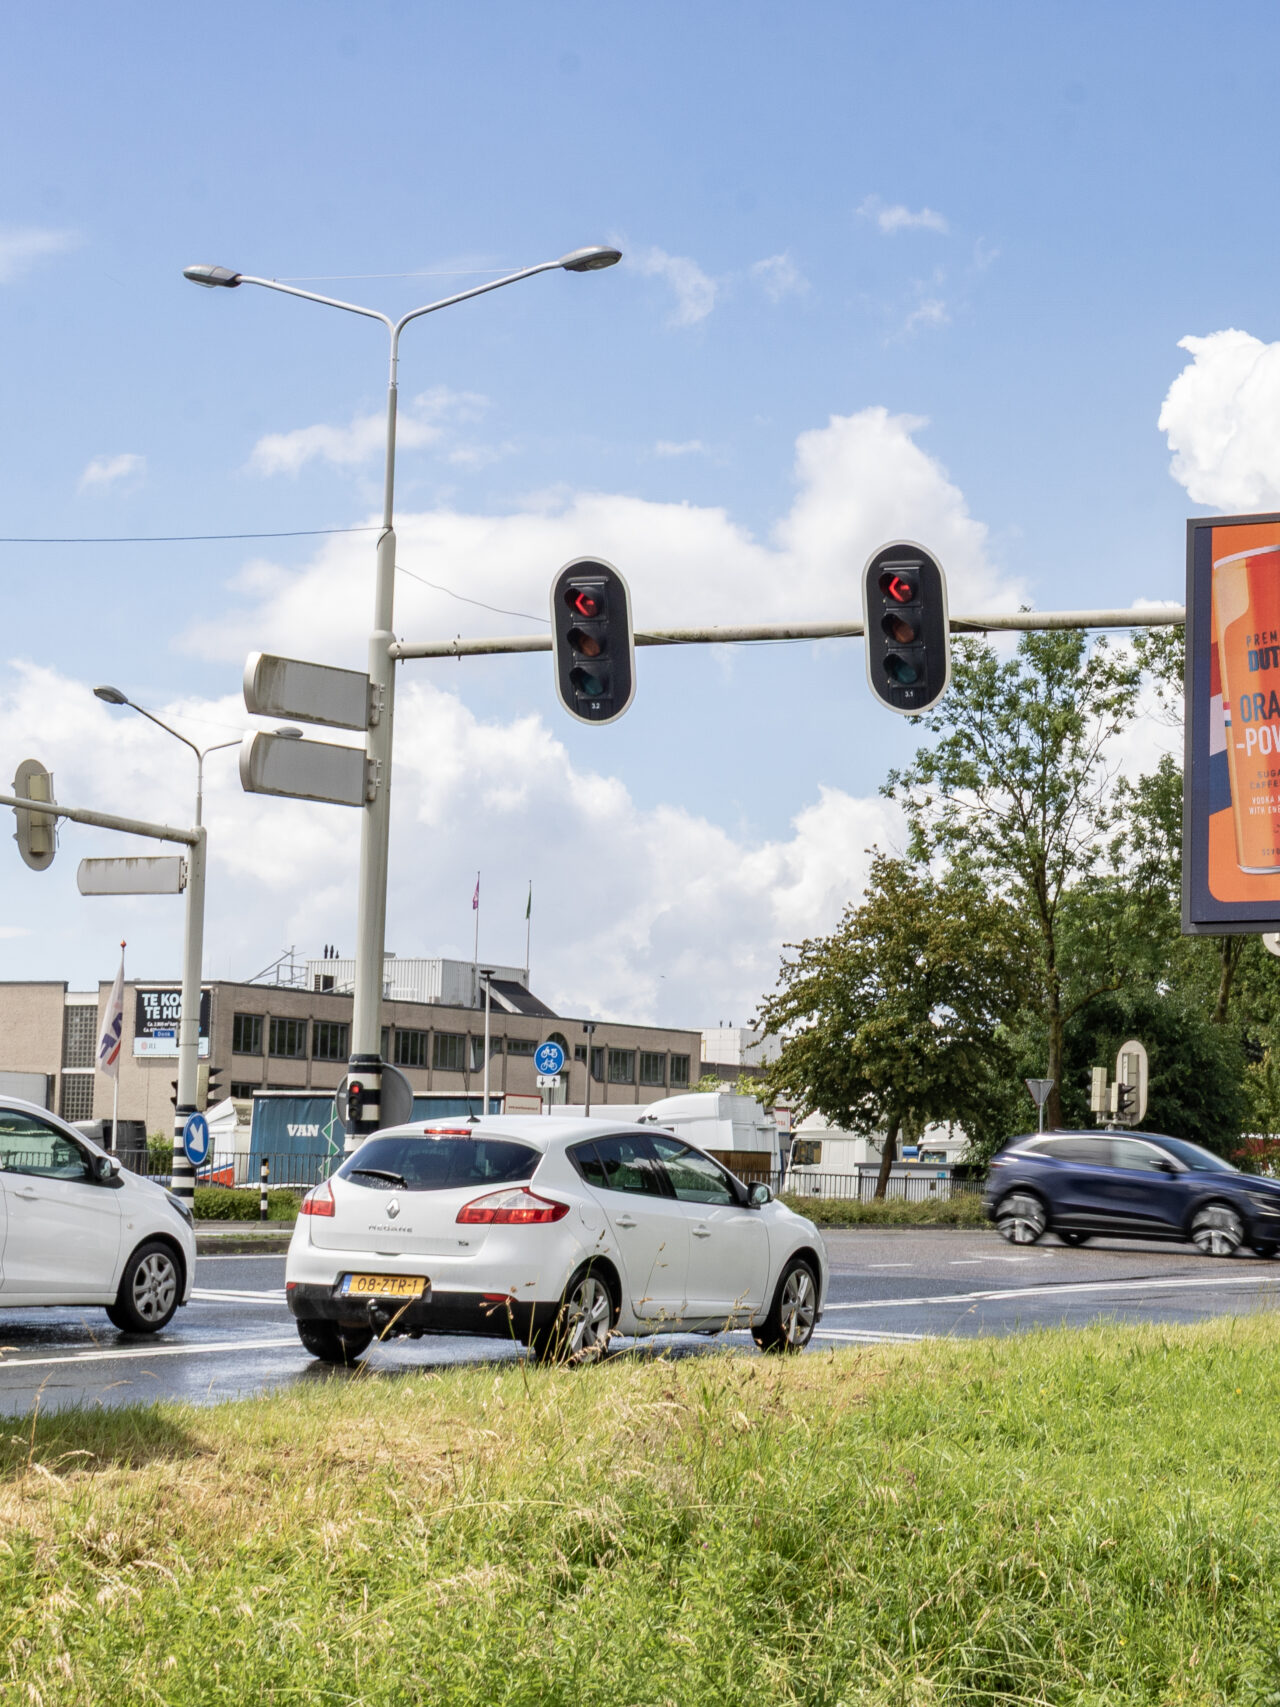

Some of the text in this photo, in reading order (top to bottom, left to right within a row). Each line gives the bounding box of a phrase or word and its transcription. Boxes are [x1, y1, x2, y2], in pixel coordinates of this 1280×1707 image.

[1249, 806, 1265, 815] WITH
[142, 994, 158, 1006] TE
[145, 1006, 160, 1019] TE
[287, 1124, 319, 1137] VAN
[358, 1277, 417, 1292] 08-ZTR-1
